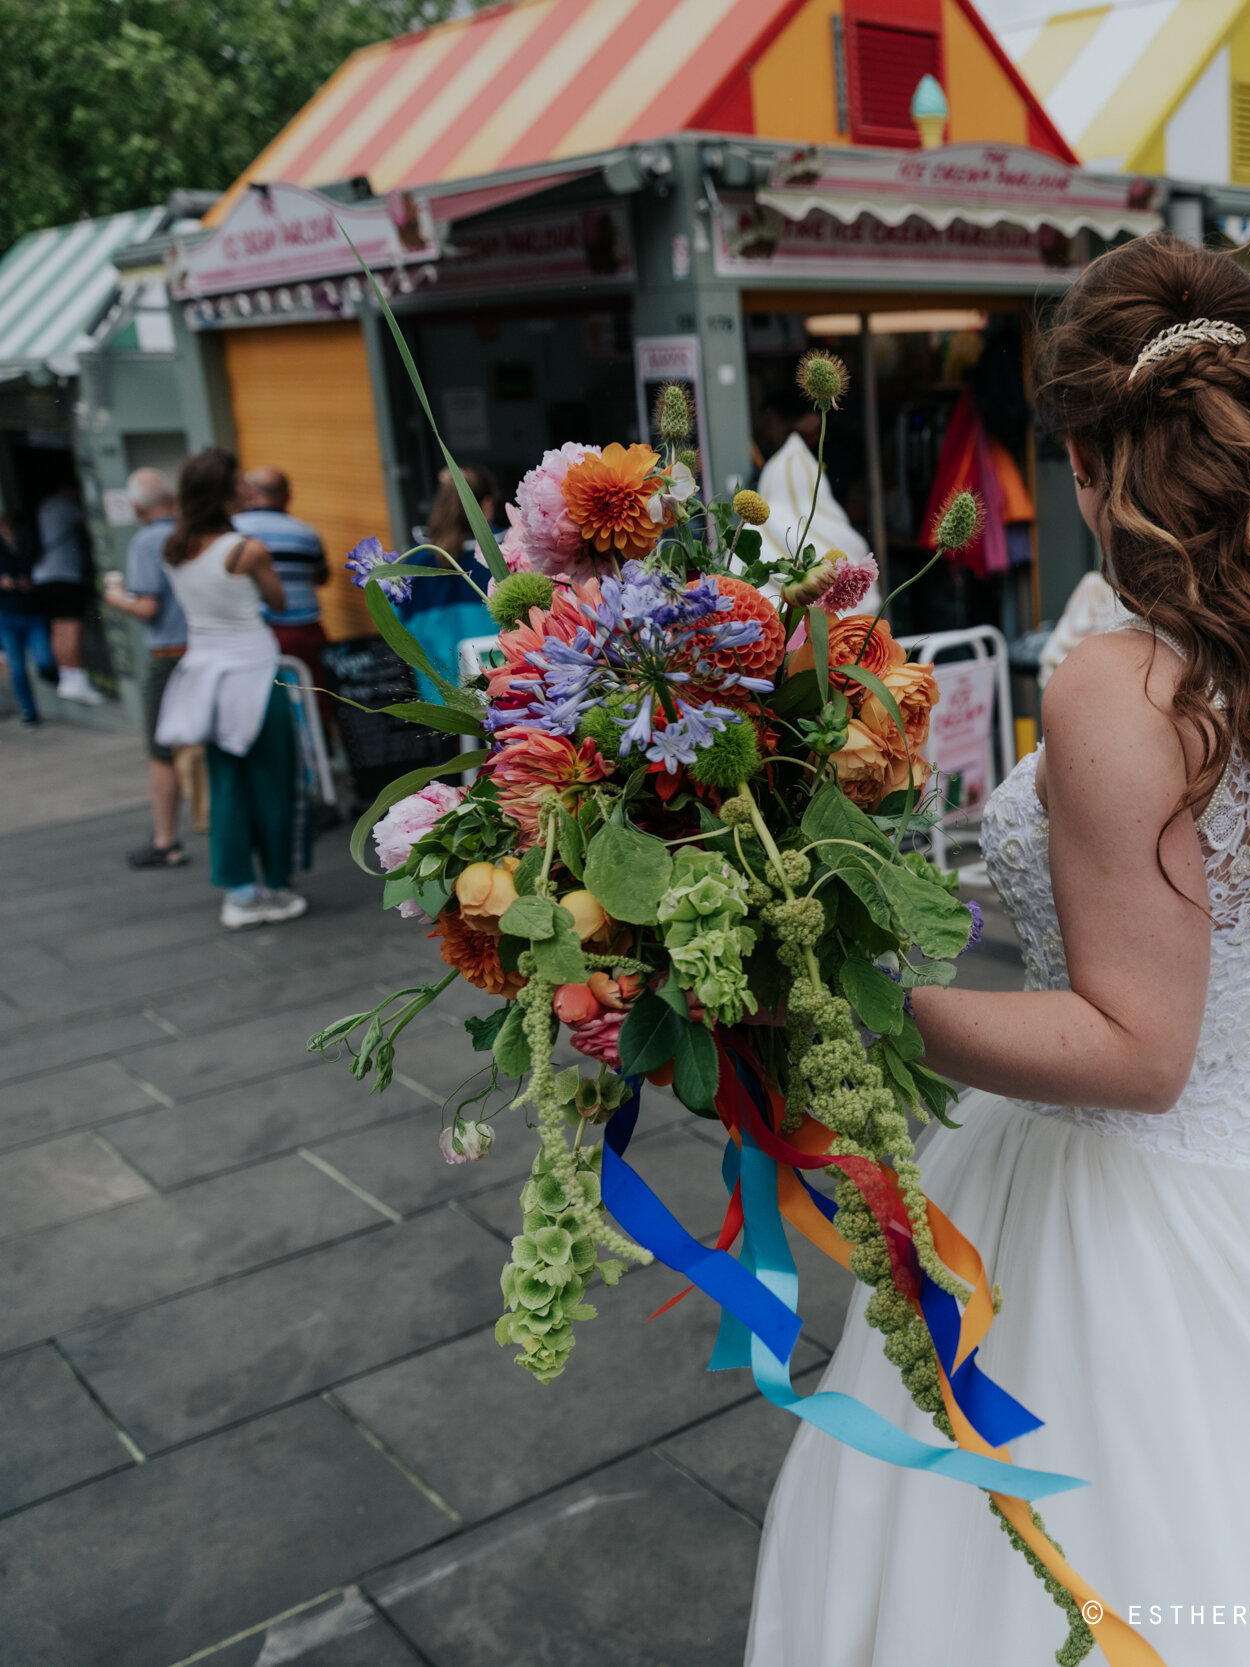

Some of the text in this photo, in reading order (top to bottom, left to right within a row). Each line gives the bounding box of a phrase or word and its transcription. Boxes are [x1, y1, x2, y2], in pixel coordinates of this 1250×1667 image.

[900, 161, 1071, 190] ICE CREAM PARLOUR
